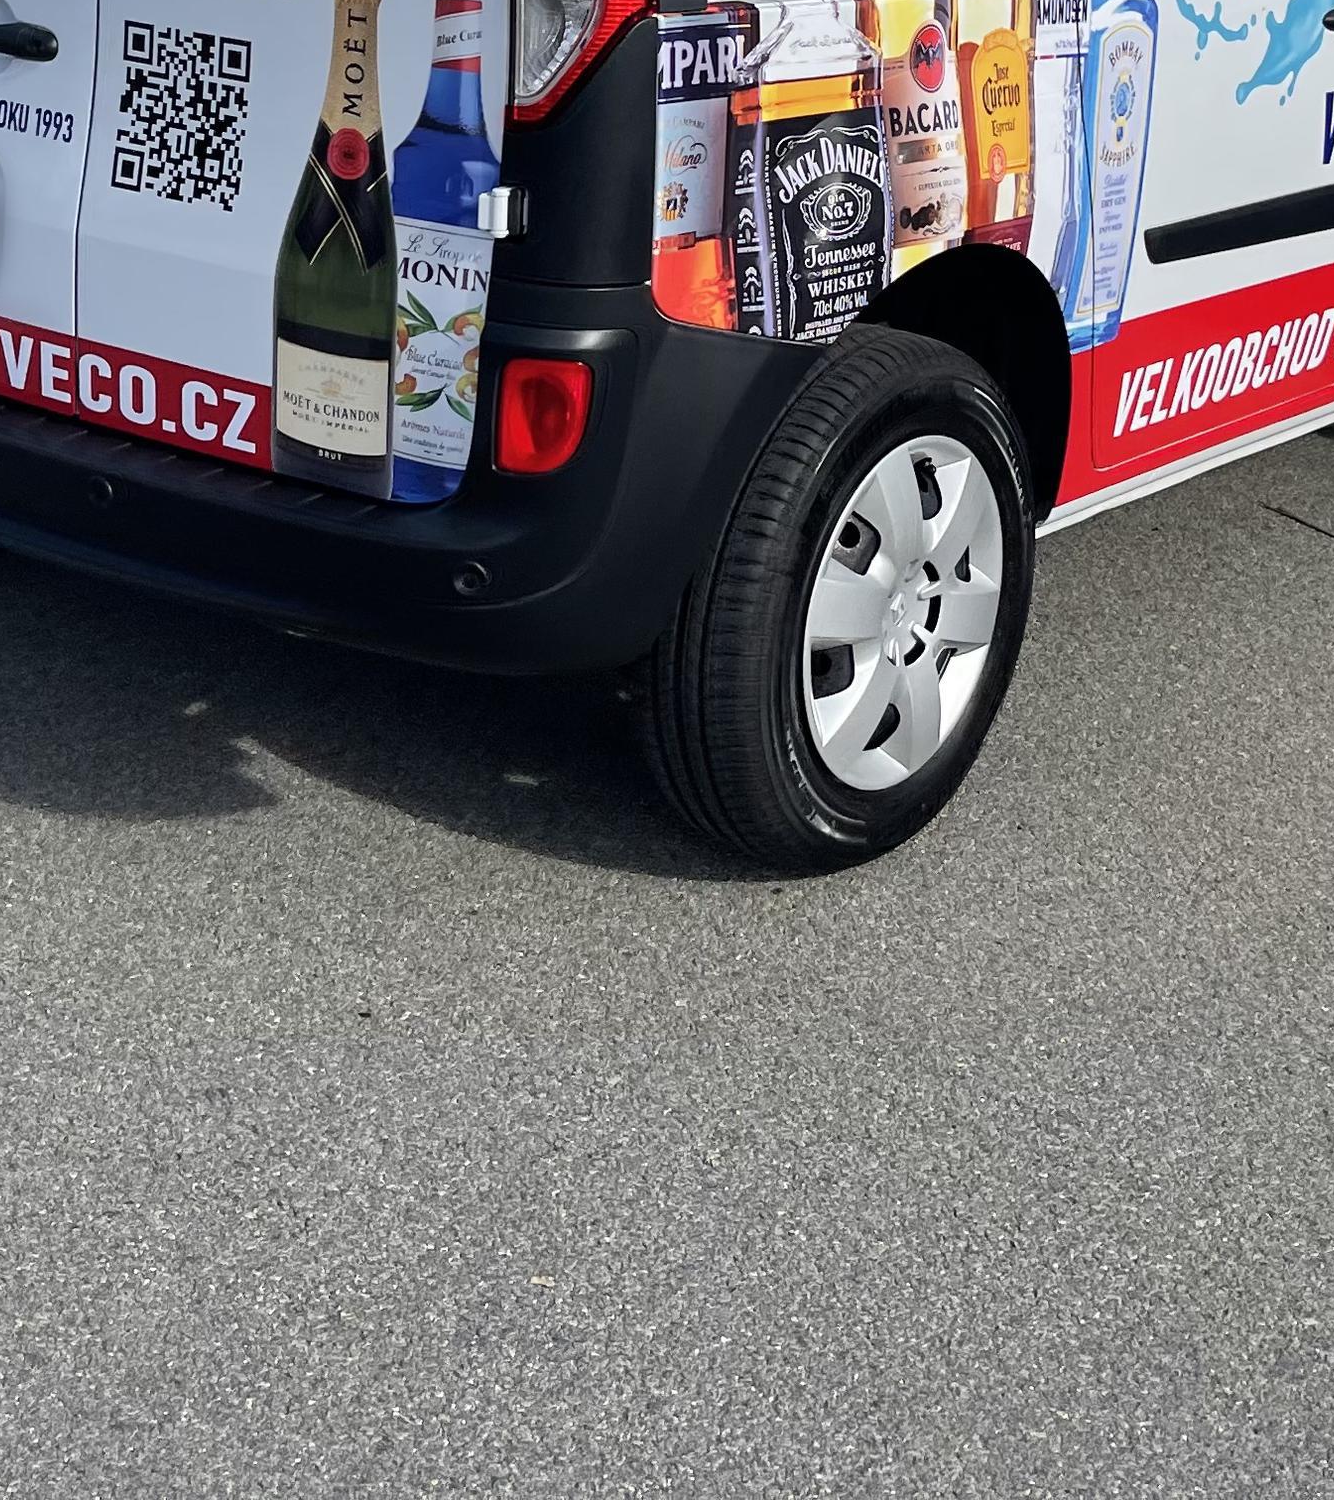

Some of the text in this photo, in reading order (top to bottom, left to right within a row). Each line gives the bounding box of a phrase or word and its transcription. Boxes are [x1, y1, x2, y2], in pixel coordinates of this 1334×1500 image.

[342, 8, 367, 117] MOËT
[1108, 40, 1144, 68] BOMBAY
[981, 76, 1021, 115] Cuervo
[34, 108, 74, 143] 1993
[774, 149, 822, 203] JACK
[804, 242, 876, 268] Tennessee
[808, 269, 875, 299] WHISKEY
[813, 299, 833, 318] 70cl
[833, 293, 854, 313] 40%
[313, 403, 321, 413] &
[323, 404, 380, 422] CHANDON
[318, 449, 342, 460] BRUT
